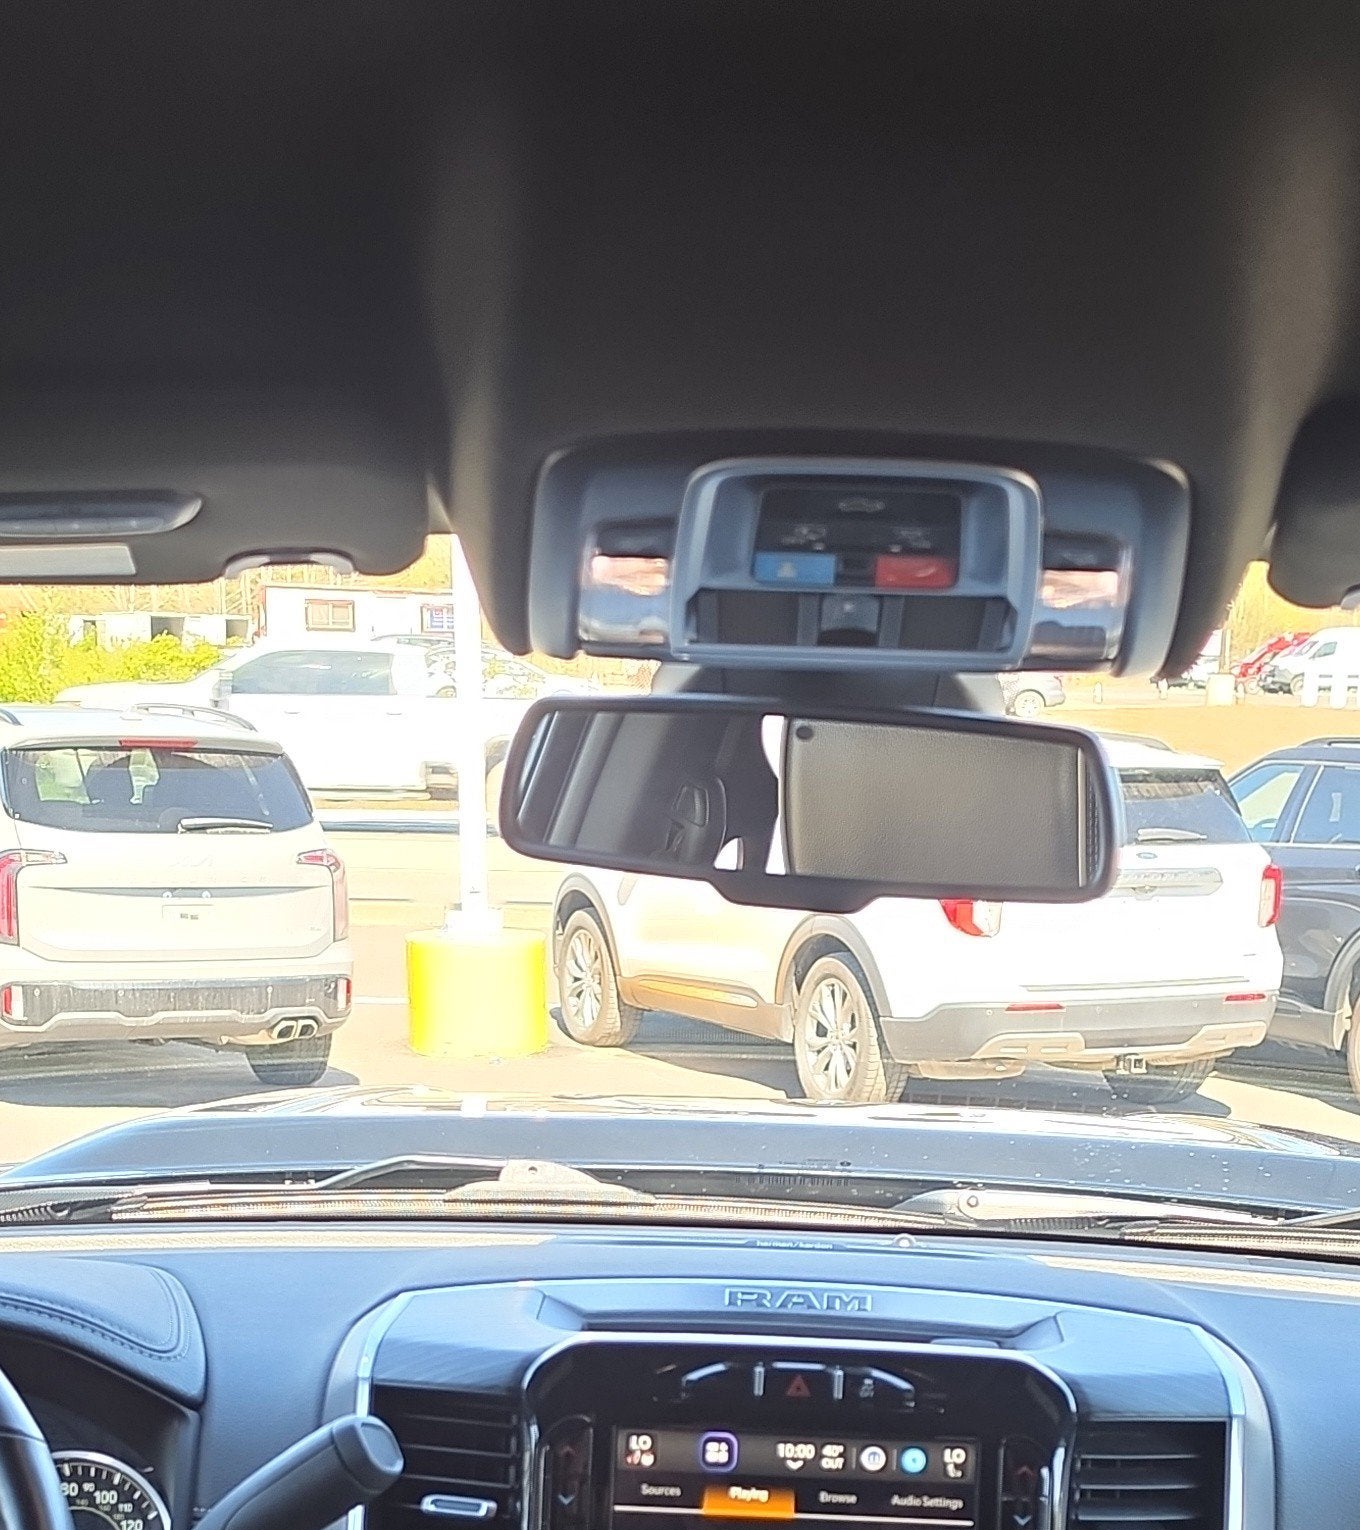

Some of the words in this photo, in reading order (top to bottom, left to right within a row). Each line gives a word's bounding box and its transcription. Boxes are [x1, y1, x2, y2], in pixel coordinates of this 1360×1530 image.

[756, 1239, 833, 1250] harman/kardon
[724, 1286, 872, 1312] RAM
[641, 1483, 682, 1497] Sources
[729, 1486, 770, 1502] Playing
[93, 1491, 118, 1505] 100
[819, 1491, 857, 1505] Browse
[892, 1494, 922, 1508] Audio
[922, 1496, 965, 1511] Settings
